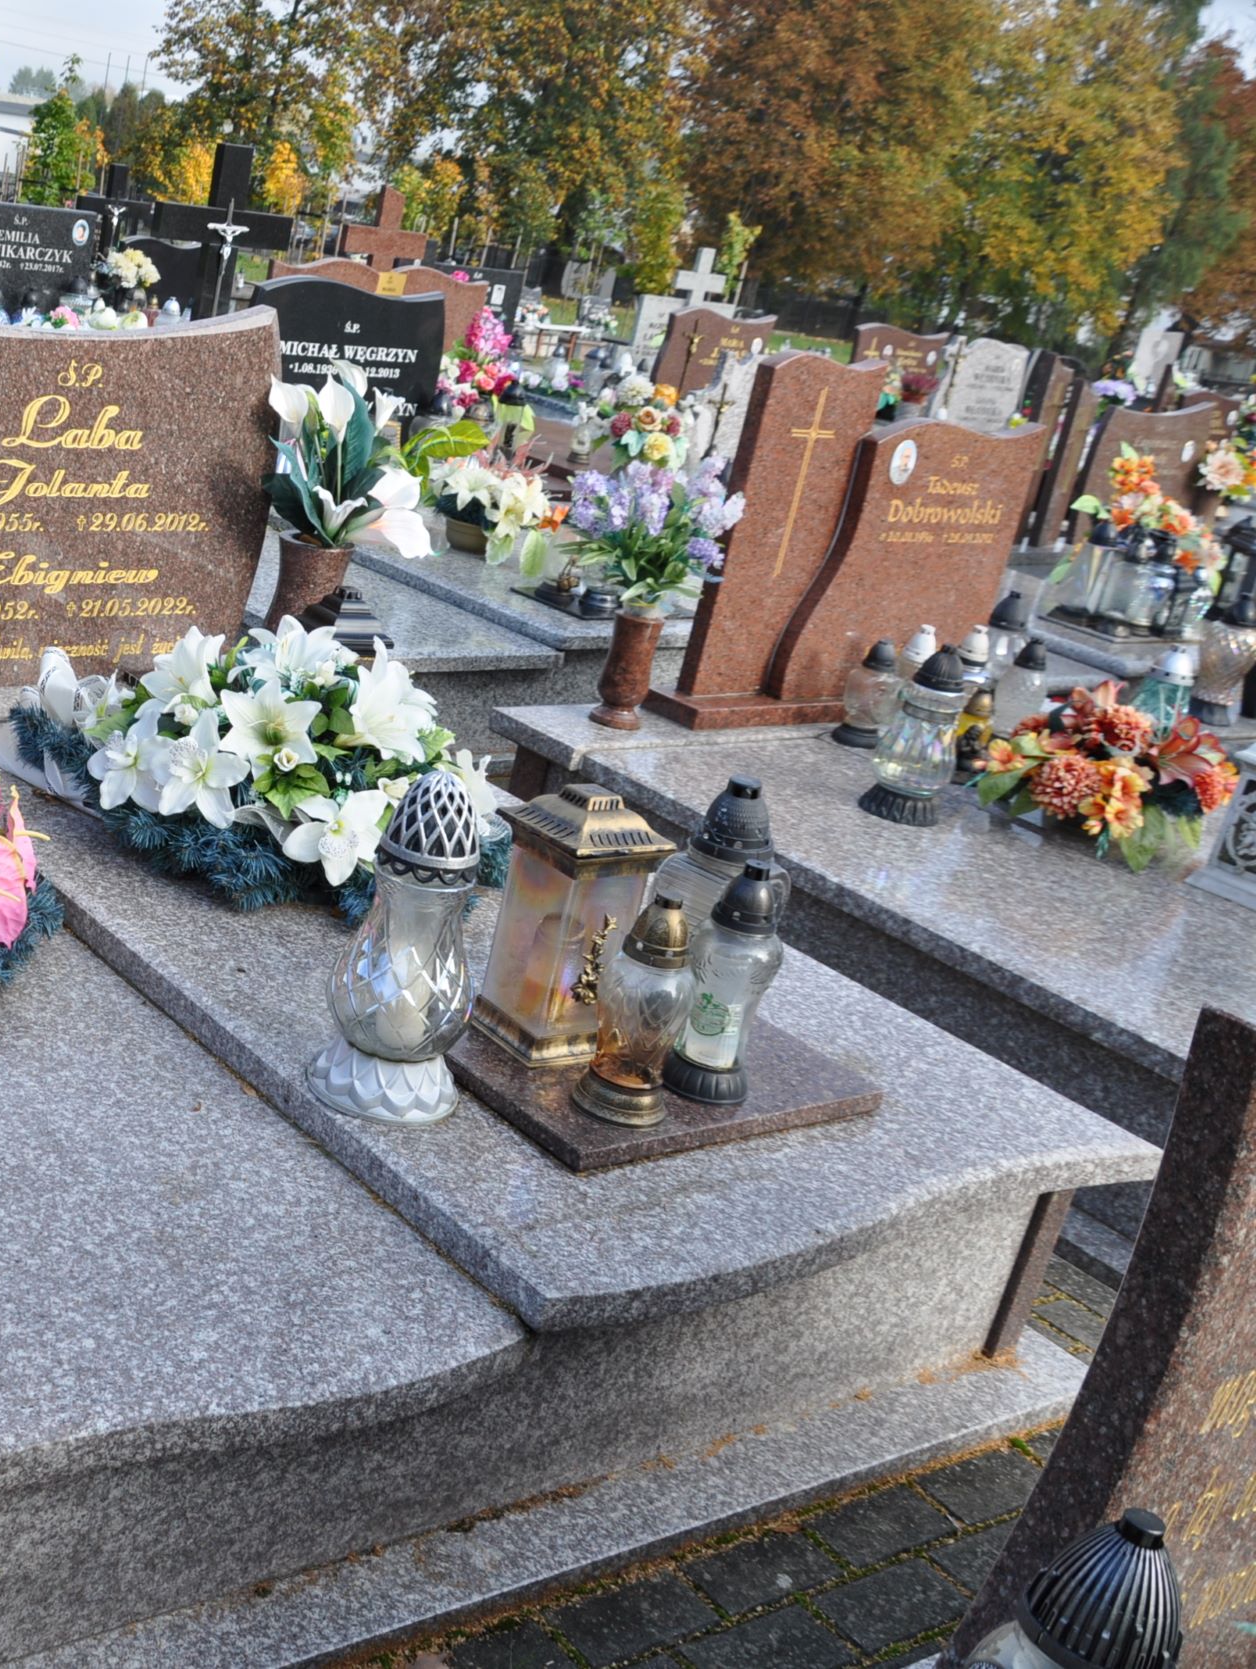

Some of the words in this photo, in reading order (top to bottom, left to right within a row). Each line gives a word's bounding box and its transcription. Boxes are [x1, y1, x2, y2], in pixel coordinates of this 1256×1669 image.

[279, 341, 341, 359] MICHAŁ
[344, 345, 418, 363] WĘGRZYN
[57, 359, 104, 388] Ś.P.
[1, 394, 143, 449] Laba
[927, 475, 980, 495] Tadeusz
[88, 512, 210, 532] 29.06.2012r.
[887, 497, 1003, 525] Dobrowolski
[79, 596, 197, 617] 21.05.2022r.
[112, 633, 145, 664] jest
